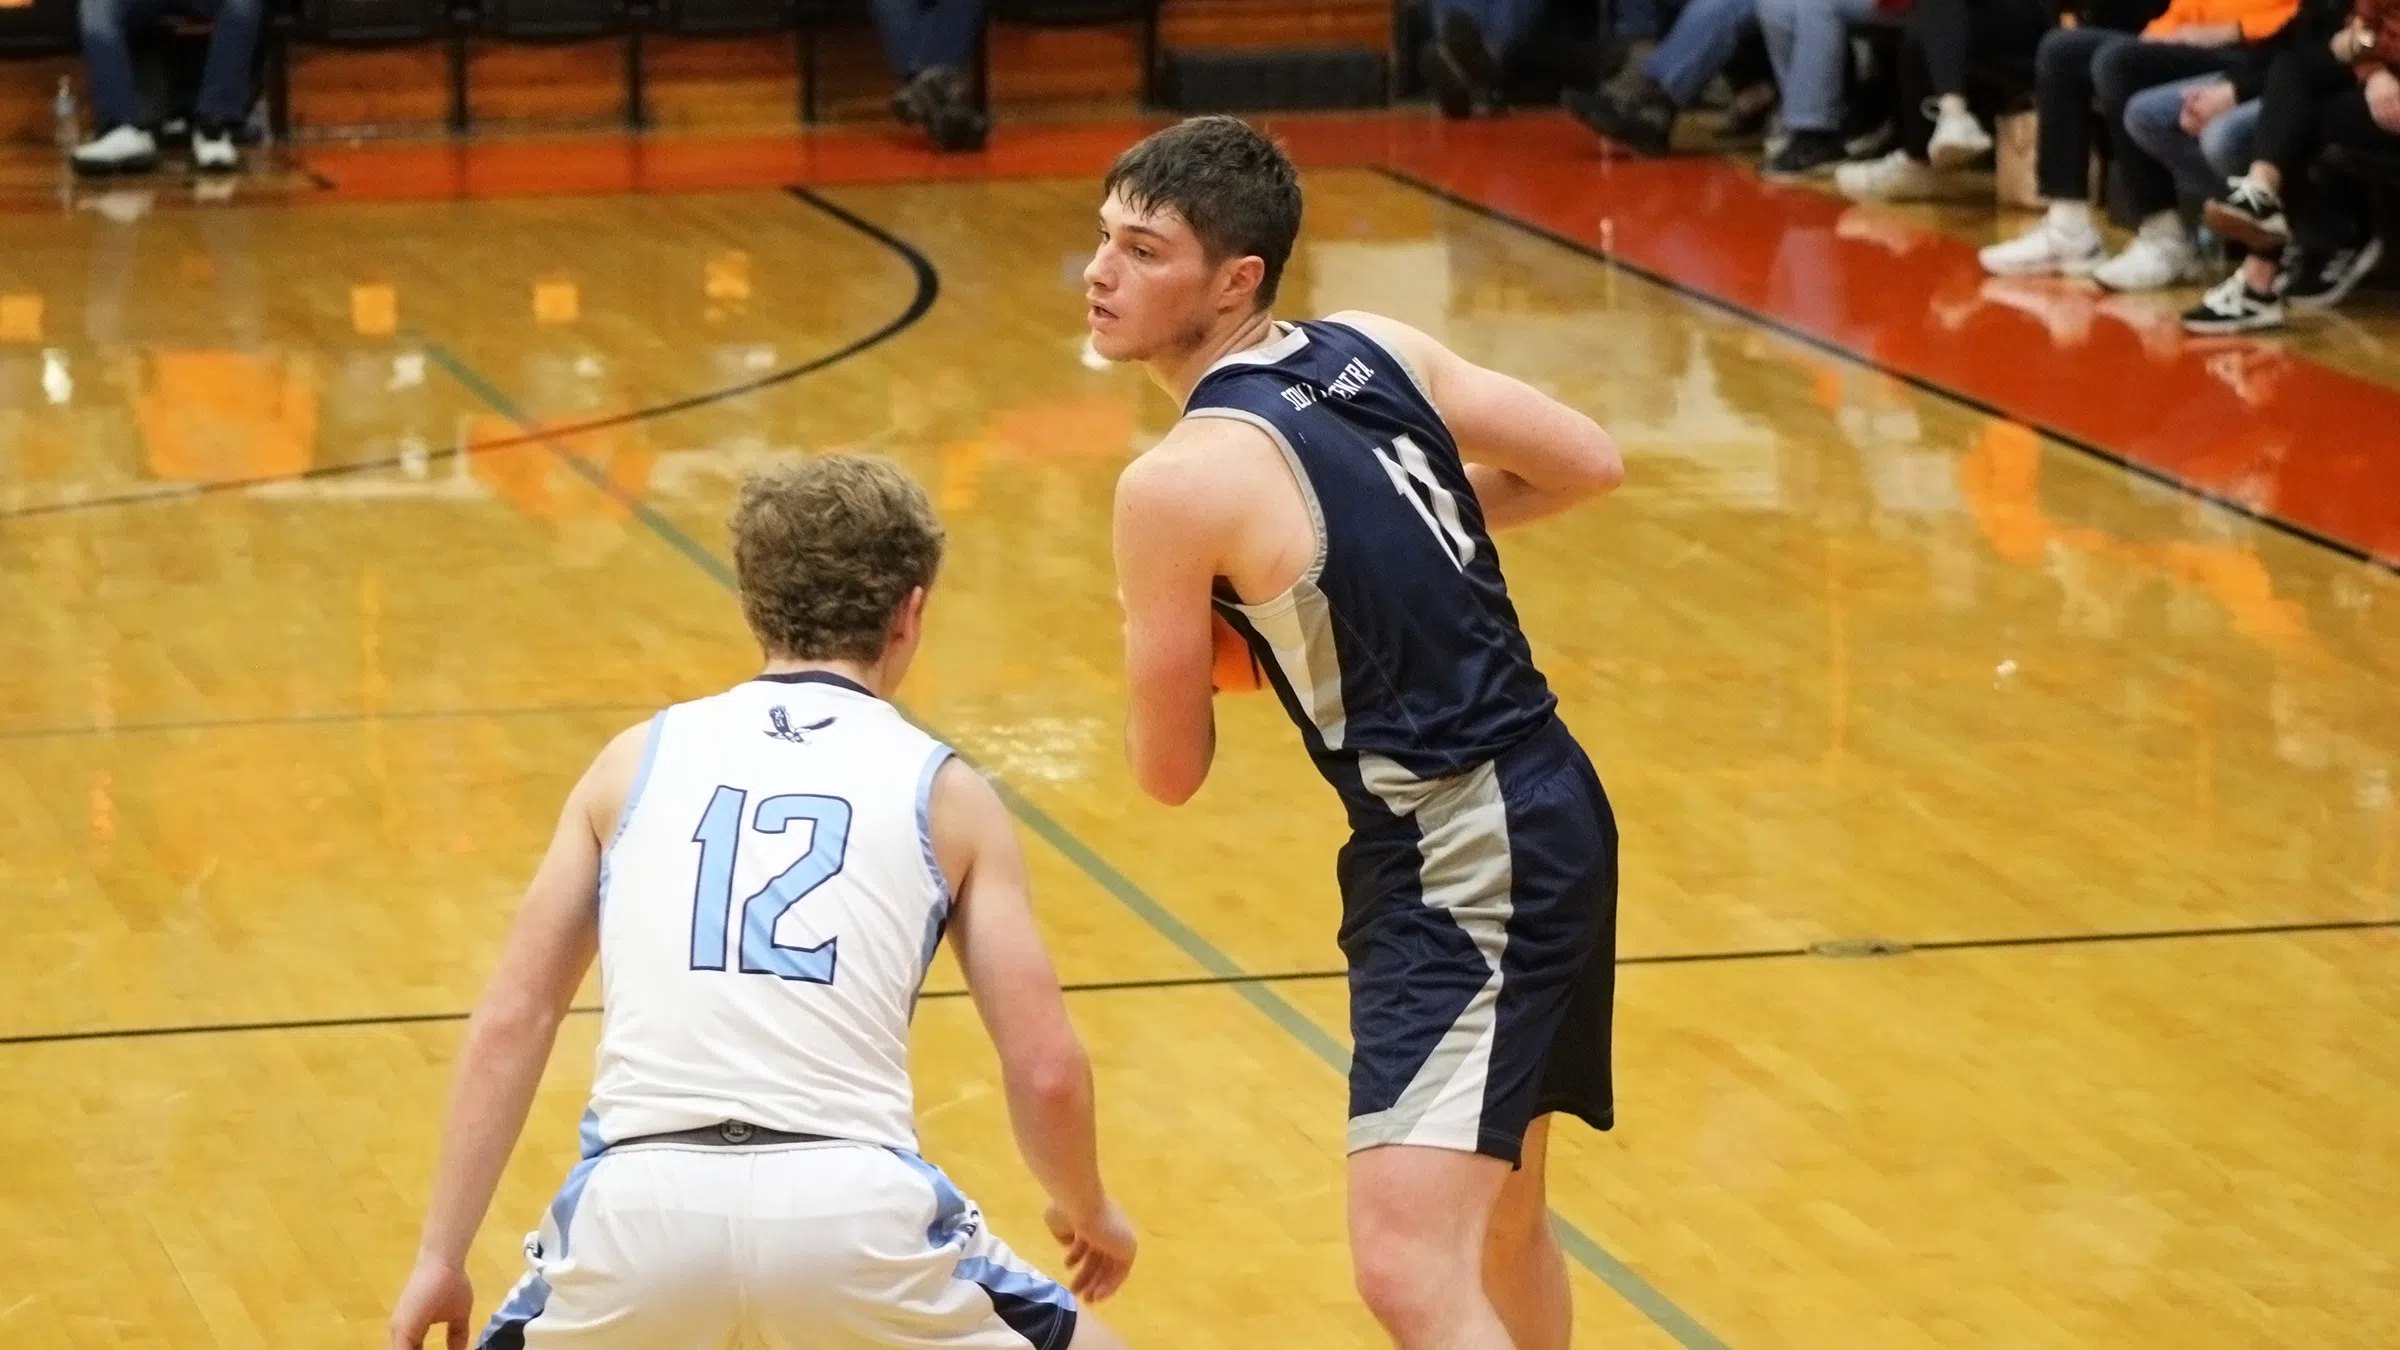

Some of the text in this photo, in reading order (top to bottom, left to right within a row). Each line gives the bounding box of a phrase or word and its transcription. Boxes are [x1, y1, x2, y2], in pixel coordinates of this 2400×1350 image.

[1280, 382, 1327, 411] SOUT
[1372, 432, 1476, 574] 11
[690, 784, 853, 986] 12
